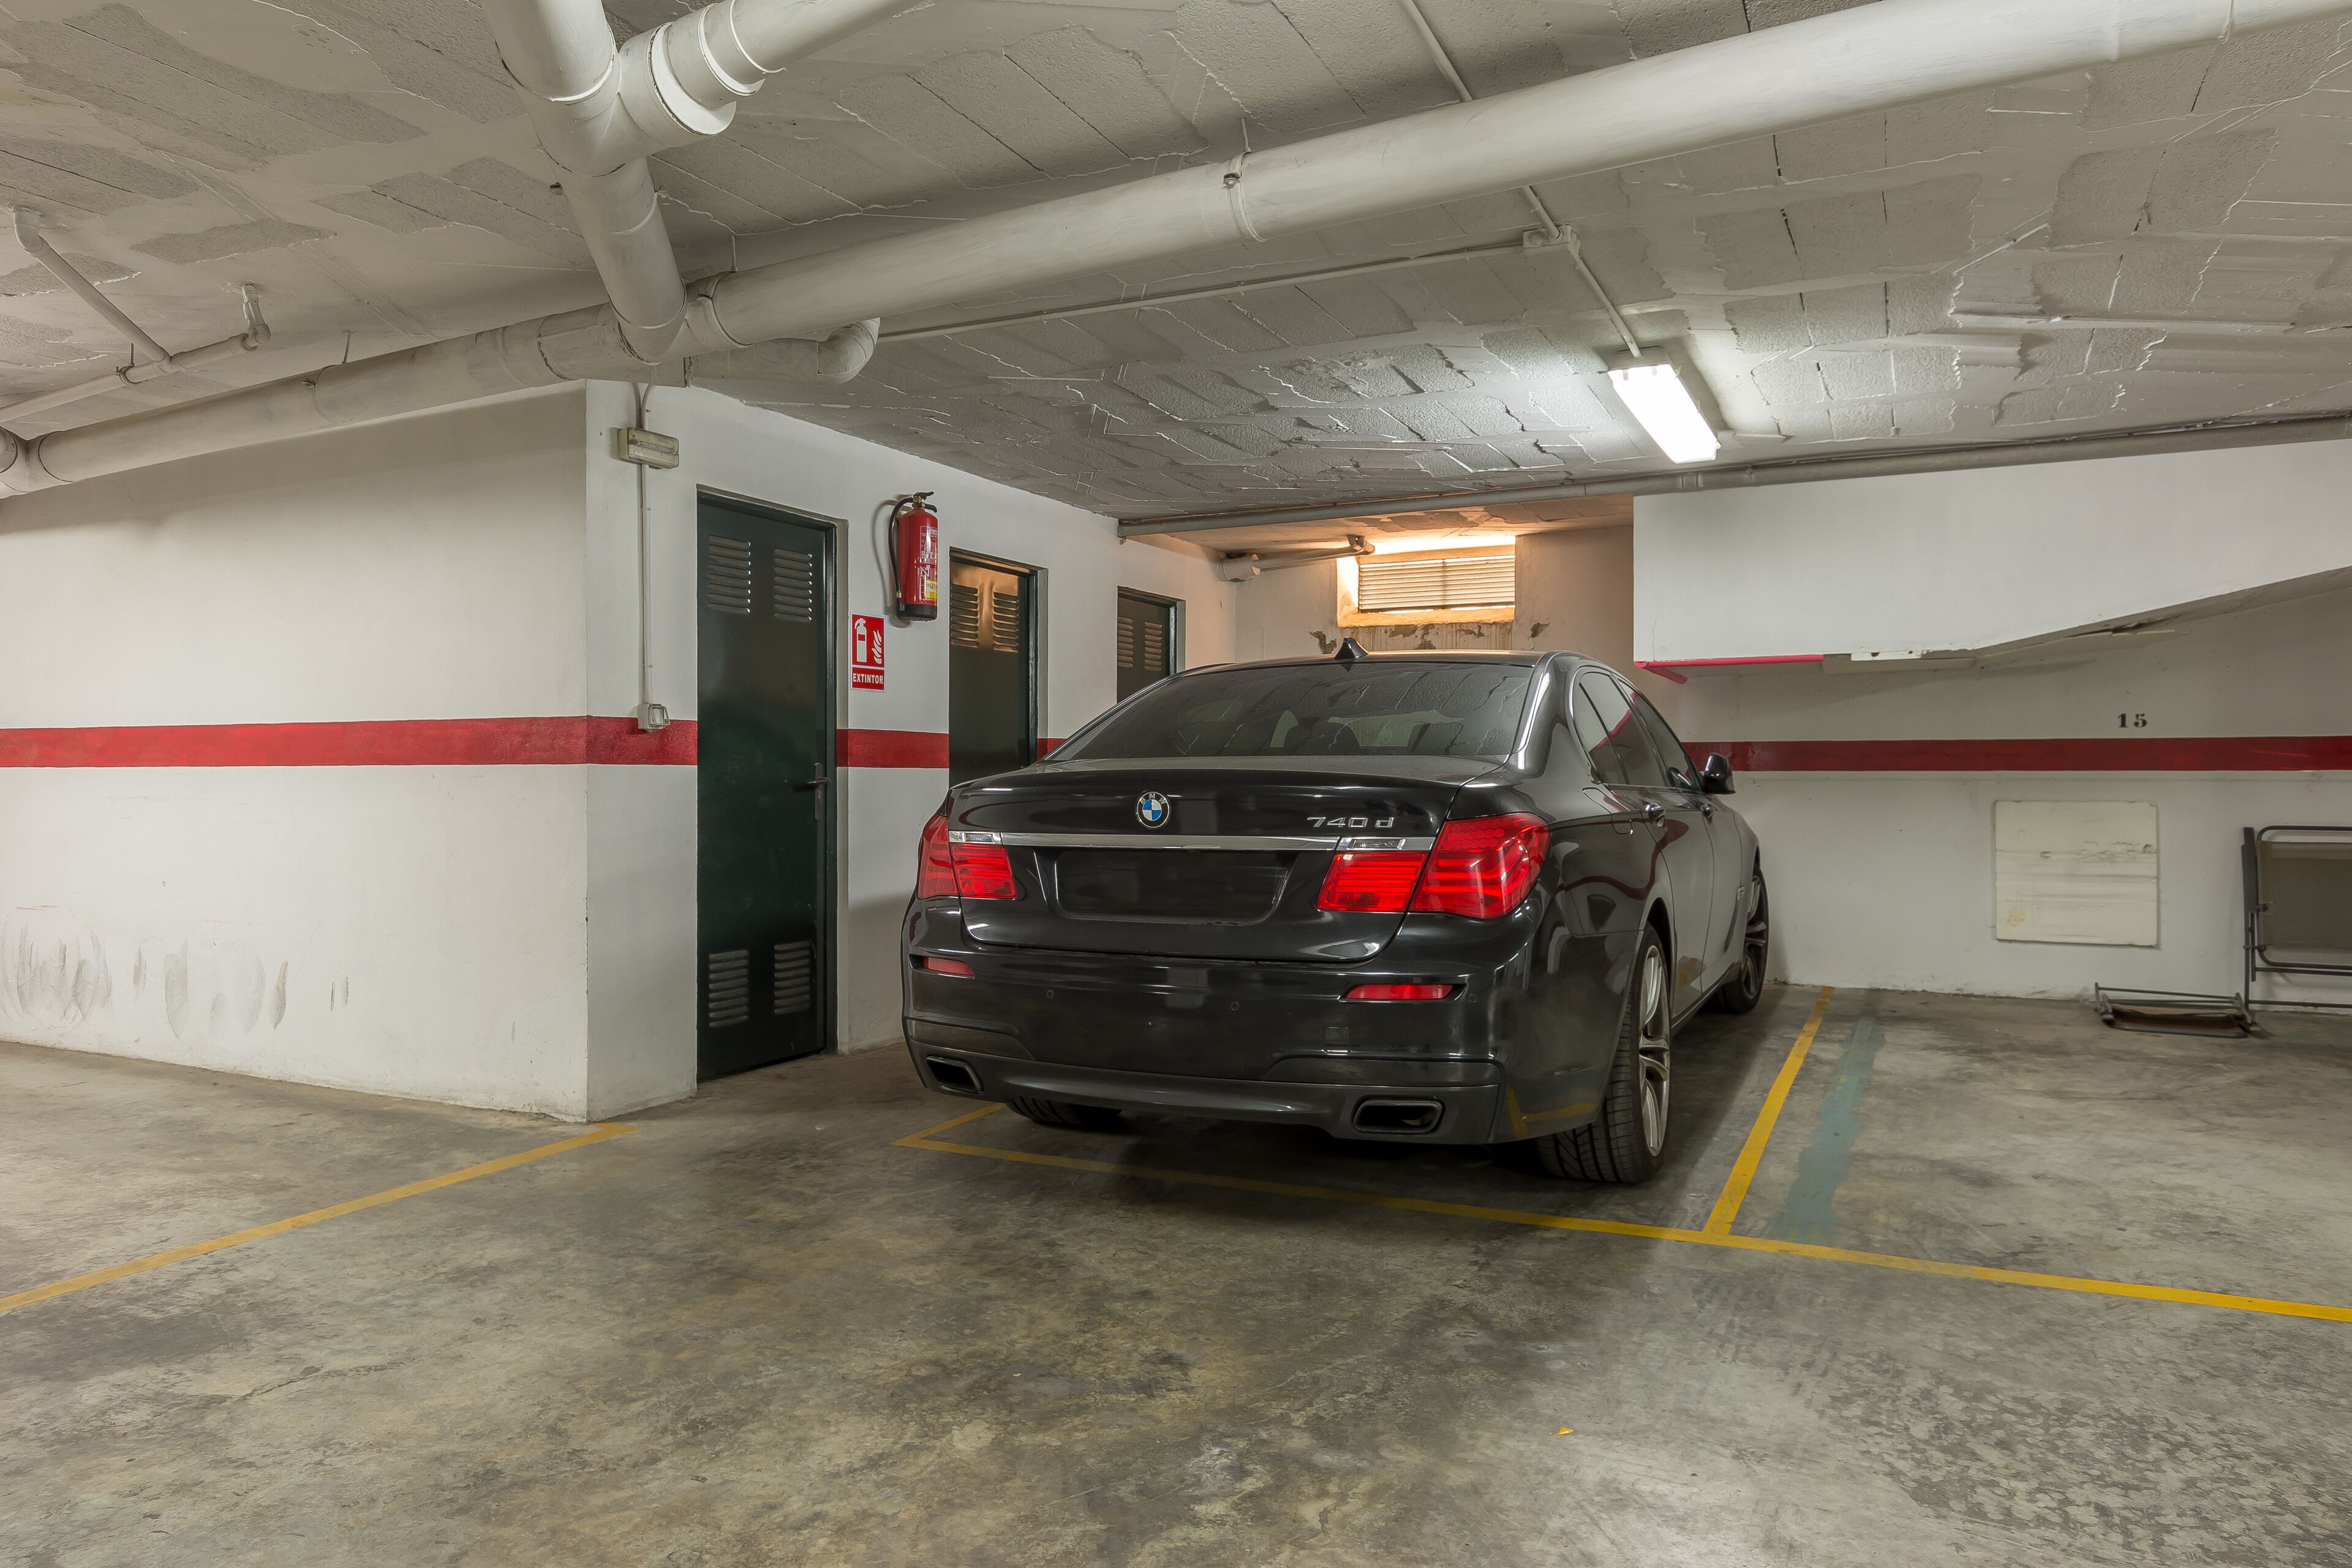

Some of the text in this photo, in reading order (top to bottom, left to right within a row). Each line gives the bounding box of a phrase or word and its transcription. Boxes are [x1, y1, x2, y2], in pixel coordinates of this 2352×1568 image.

[853, 673, 883, 684] EXTINTOR
[2117, 713, 2147, 728] 15
[1139, 793, 1167, 805] BMW
